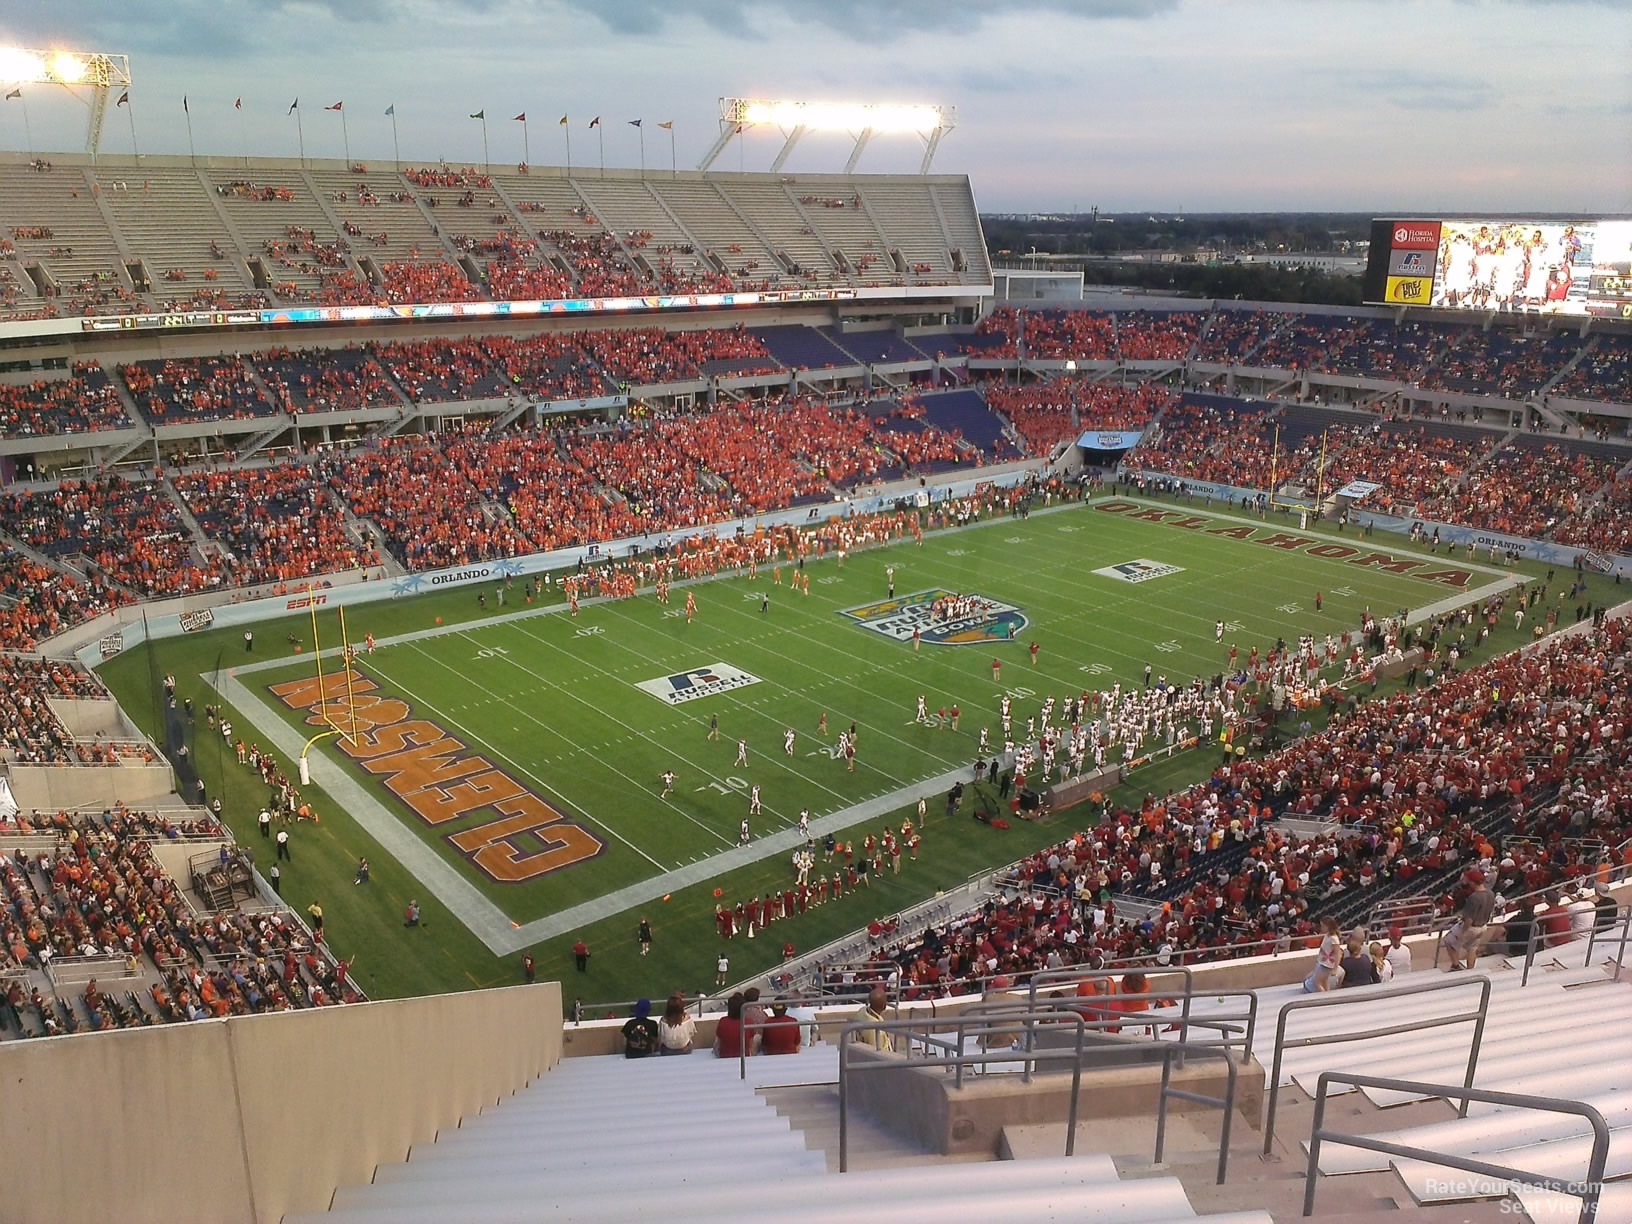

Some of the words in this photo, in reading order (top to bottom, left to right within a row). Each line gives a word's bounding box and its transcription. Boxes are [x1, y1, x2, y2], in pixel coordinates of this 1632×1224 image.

[1402, 280, 1422, 291] TIRES
[1404, 287, 1422, 299] PLUS
[1182, 482, 1215, 494] RLANDO
[1093, 501, 1475, 588] OKLAHOMA
[1477, 535, 1527, 552] ORLANDO
[431, 568, 490, 585] ORLANDO
[286, 594, 328, 610] ESPN
[1079, 663, 1113, 675] 50
[667, 674, 752, 699] RUSSELL
[1005, 686, 1037, 699] 40
[708, 776, 749, 796] 10
